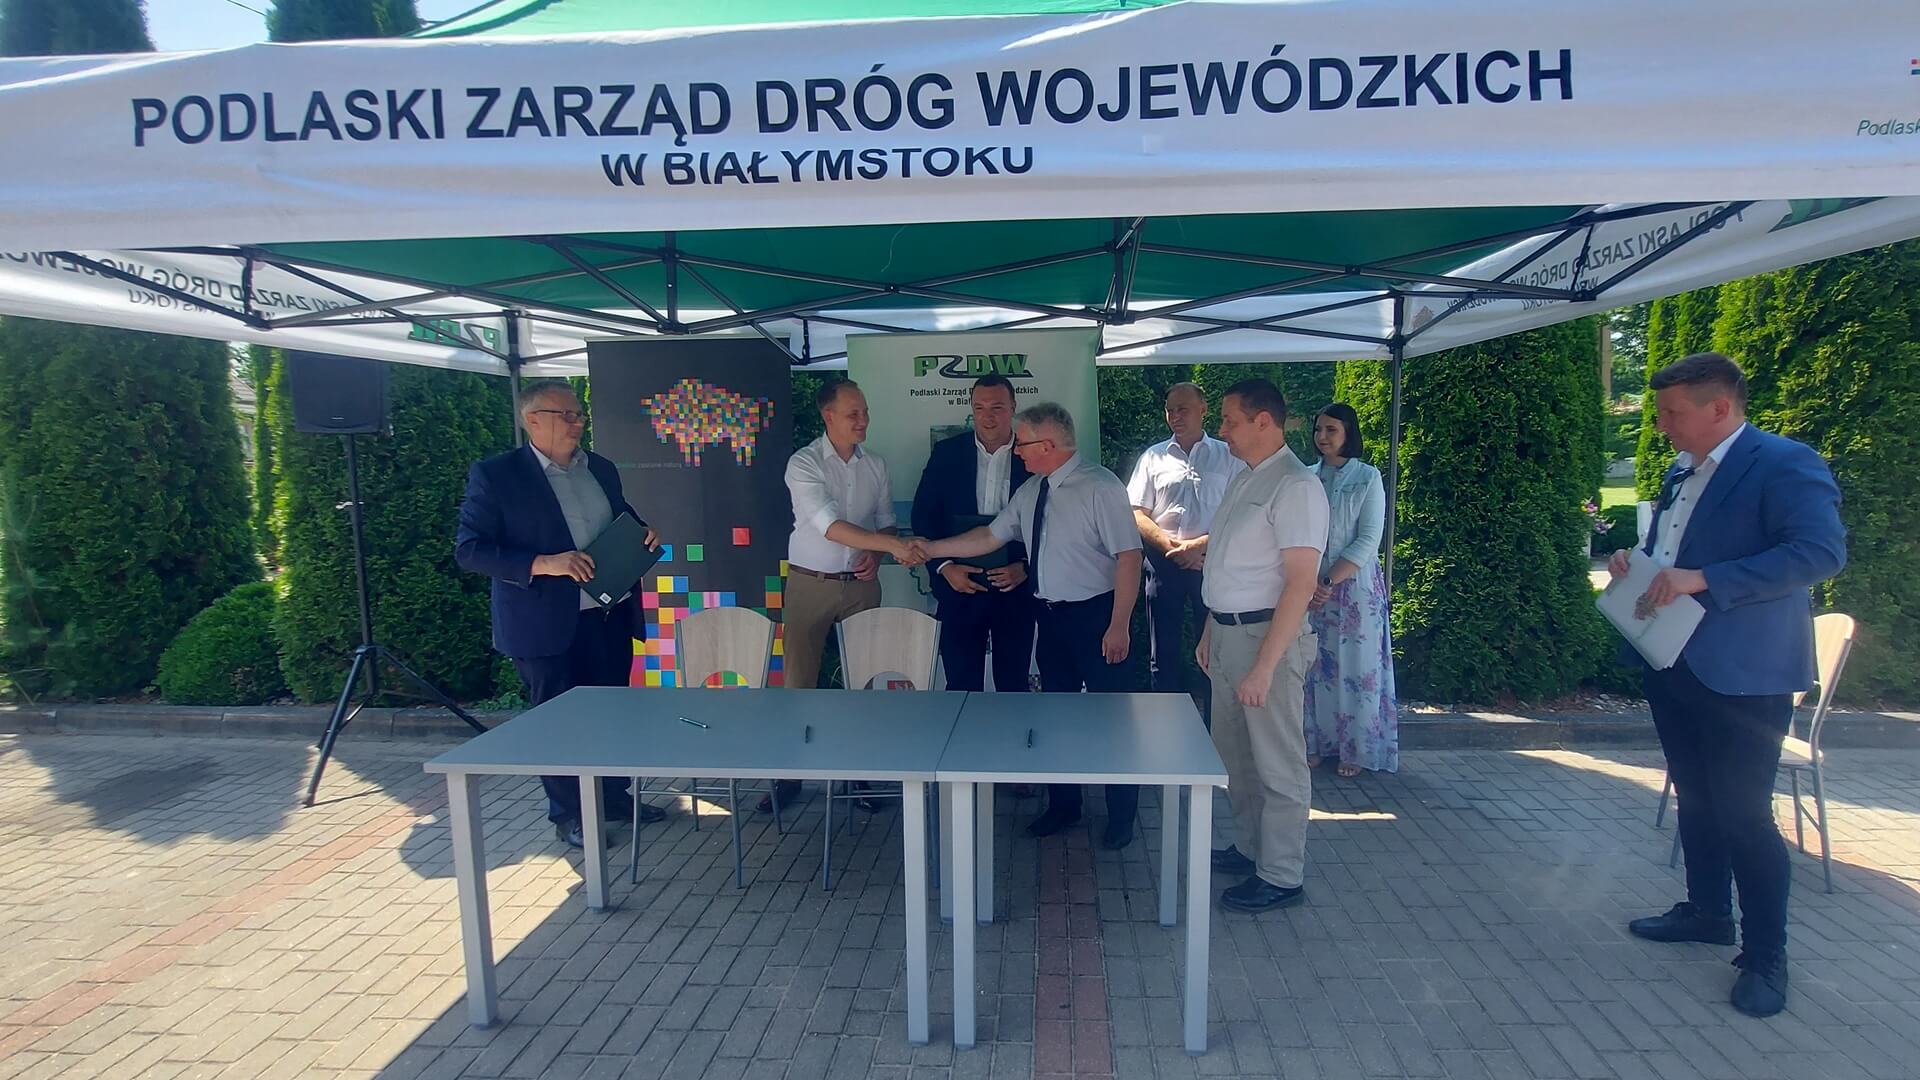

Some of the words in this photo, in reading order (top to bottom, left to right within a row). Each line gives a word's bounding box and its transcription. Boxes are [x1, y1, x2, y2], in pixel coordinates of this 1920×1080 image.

[131, 88, 445, 147] PODLASKI
[465, 83, 732, 147] ZARZĄD
[755, 63, 955, 134] DRÓG
[976, 45, 1573, 127] WOJEWÓDZKICH
[601, 153, 648, 187] W
[663, 146, 1034, 186] BIAŁYMSTOKU
[913, 354, 1034, 378] PZDW
[910, 387, 940, 397] Podlaski
[942, 387, 966, 398] Zarząd
